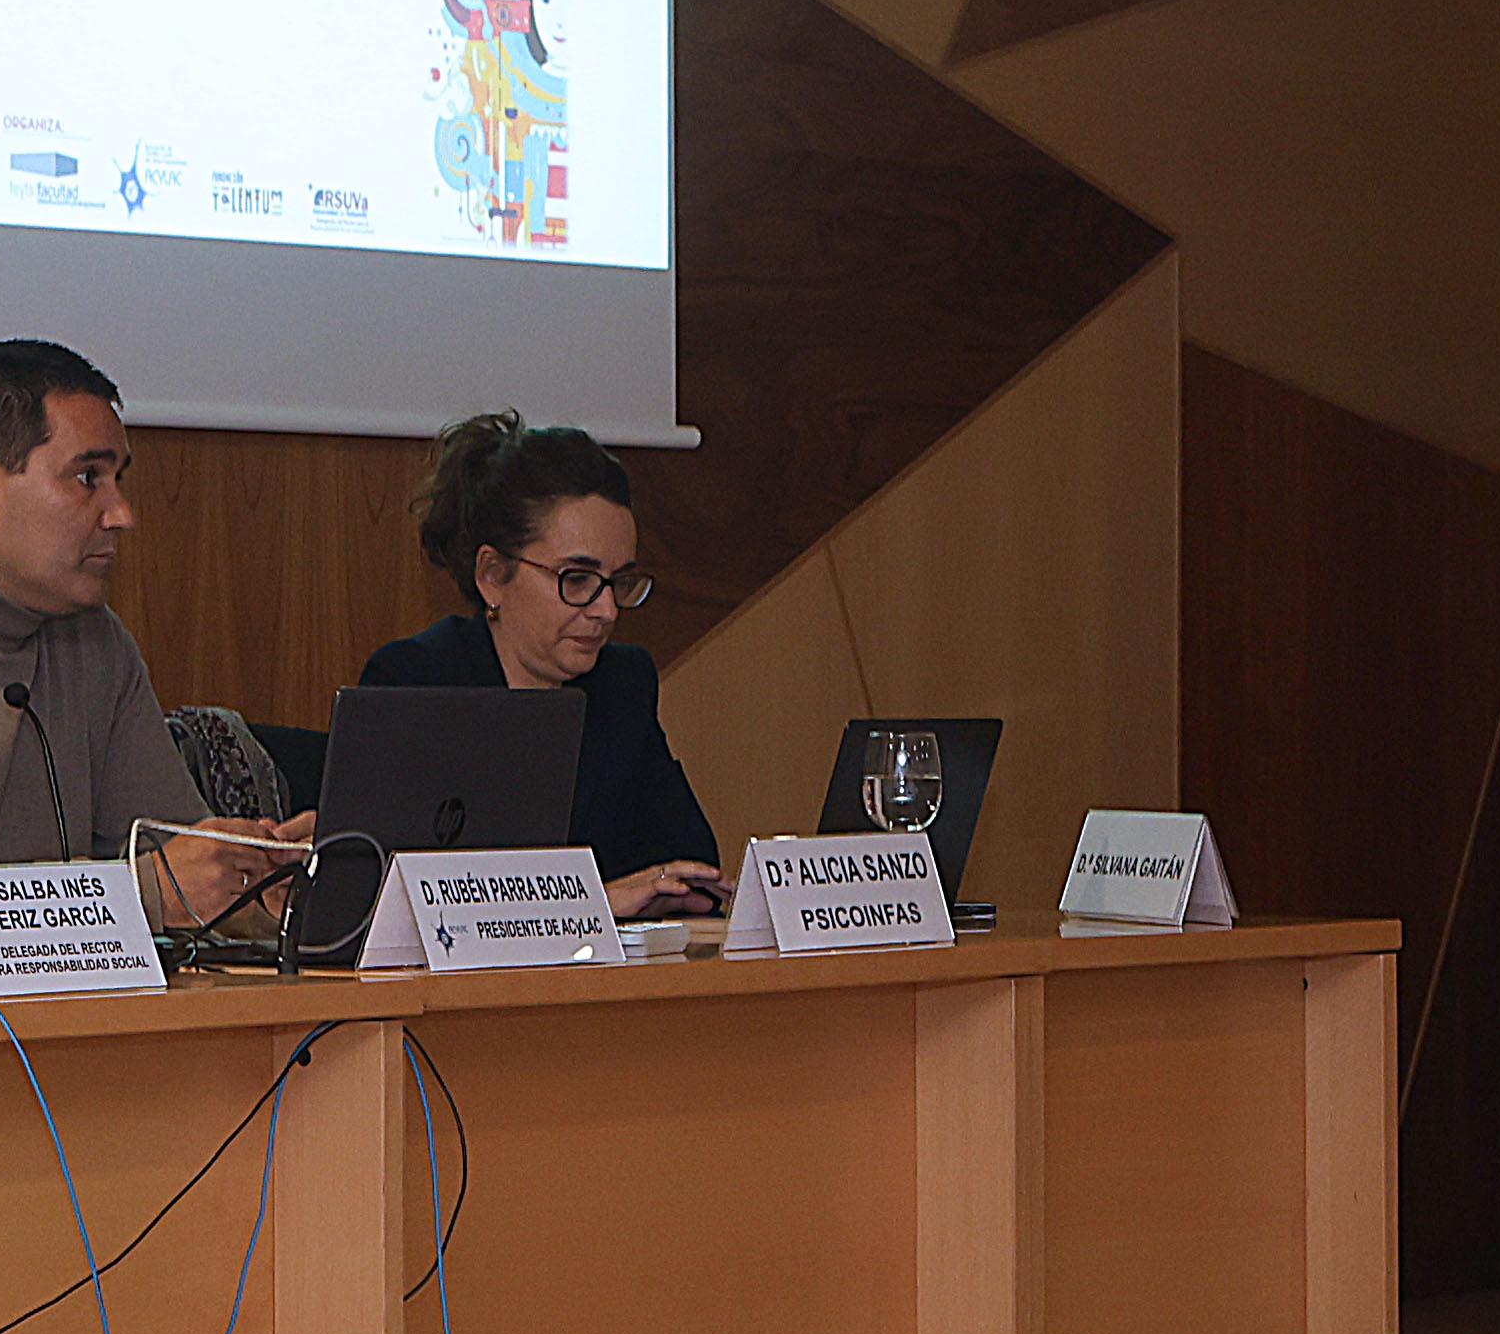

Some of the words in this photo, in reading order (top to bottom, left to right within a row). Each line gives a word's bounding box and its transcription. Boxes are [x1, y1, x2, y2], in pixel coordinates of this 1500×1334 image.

[799, 853, 863, 885] ALICIA
[862, 850, 929, 883] SANZO
[1092, 853, 1139, 878] SILVANA
[1139, 852, 1185, 880] GAITÁN
[62, 872, 106, 898] INÉS
[420, 879, 440, 906] D.
[440, 871, 490, 905] RUBÉN
[490, 876, 540, 903] PARRA
[539, 873, 589, 901] BOADA
[44, 901, 117, 928] GARCÍA
[476, 918, 544, 940] PRESIDENTE
[546, 919, 562, 936] DE
[561, 916, 603, 939] ACyLAC
[800, 901, 923, 932] PSICOINFAS
[0, 944, 58, 959] DELEGADA
[58, 942, 80, 957] DEL
[81, 940, 124, 955] RECTOR
[15, 957, 110, 975] RESPONSABILIDAD
[111, 954, 150, 970] SOCIAL
